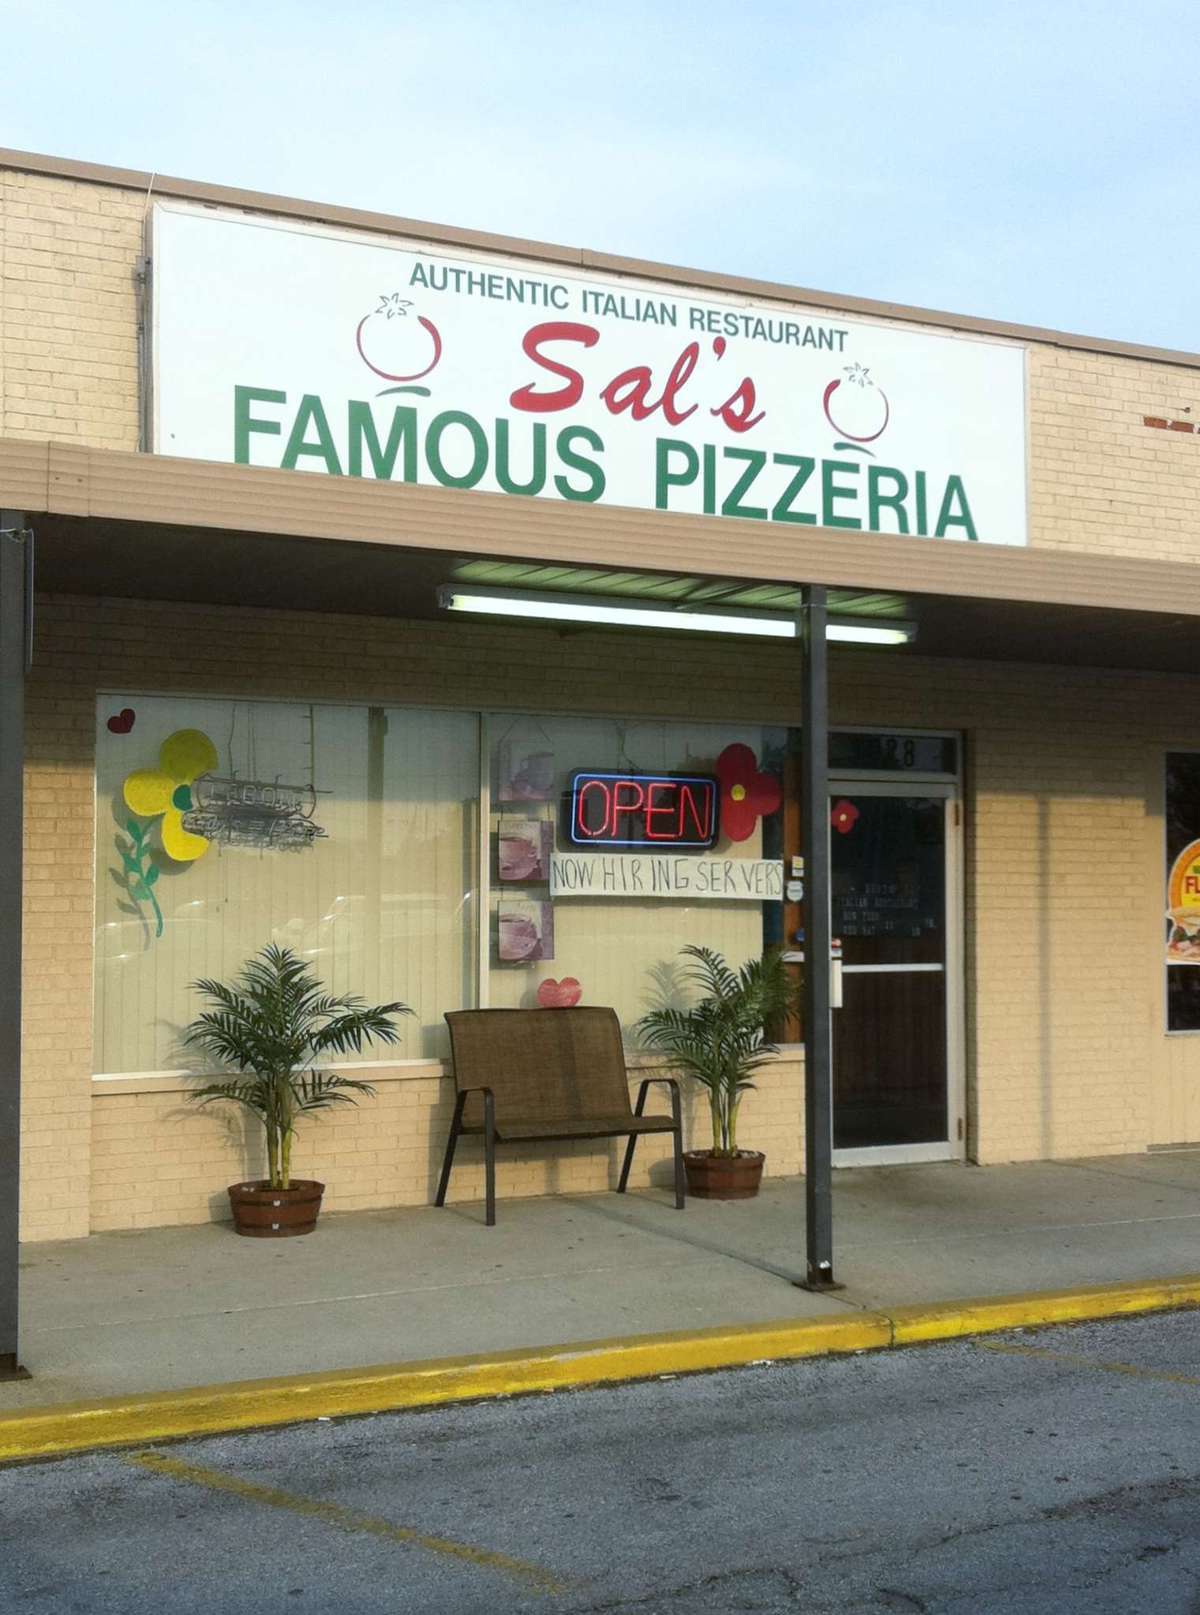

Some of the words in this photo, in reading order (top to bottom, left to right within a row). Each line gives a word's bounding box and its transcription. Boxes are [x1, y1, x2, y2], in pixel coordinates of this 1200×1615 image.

[408, 262, 570, 310] AUTHENTIC
[581, 289, 678, 327] ITALIAN
[689, 306, 849, 353] RESTAURANT
[509, 321, 766, 433] Sal's
[234, 385, 607, 504] FAMOUS
[656, 436, 980, 543] PIZZERIA
[578, 780, 711, 839] OPEN
[552, 857, 596, 890] NOW
[602, 856, 690, 892] HIRING
[695, 860, 784, 896] SERVERS
